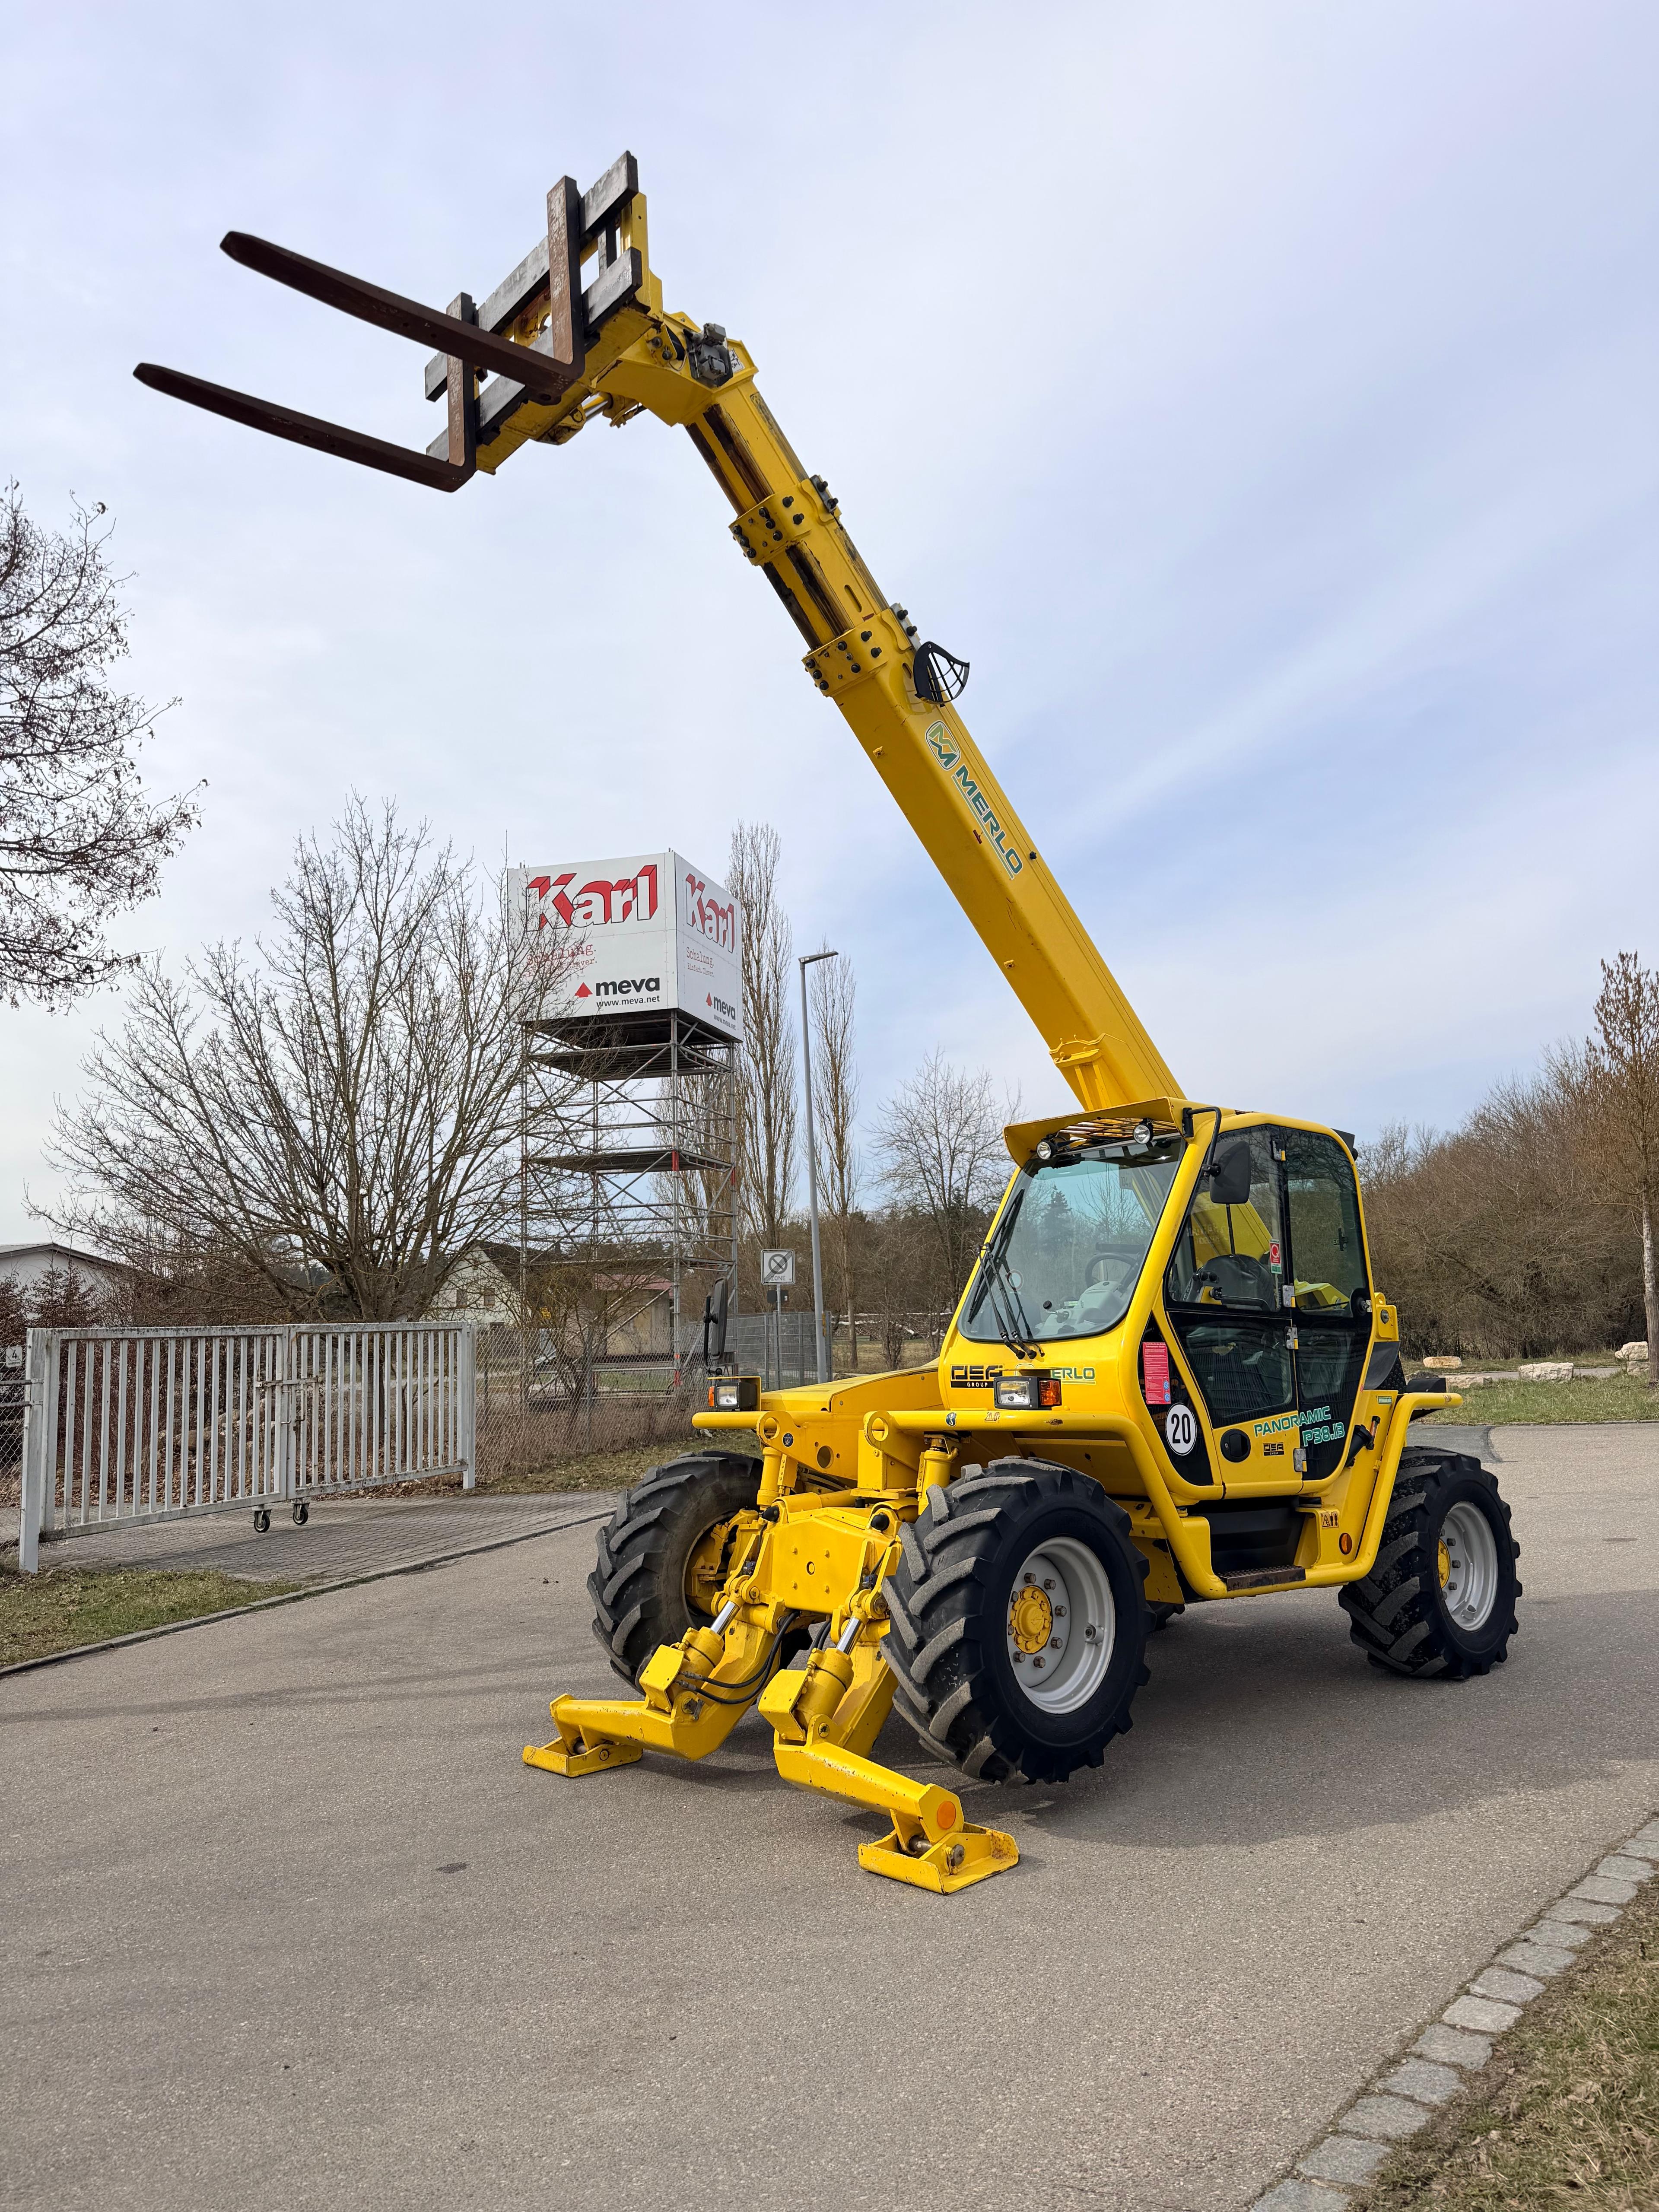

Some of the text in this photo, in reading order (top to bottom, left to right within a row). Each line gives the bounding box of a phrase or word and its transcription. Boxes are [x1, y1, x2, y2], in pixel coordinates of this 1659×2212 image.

[955, 764, 1023, 874] MERLO
[526, 864, 658, 931] Karl
[686, 873, 734, 953] Karl
[596, 977, 660, 996] meva
[596, 995, 660, 1007] www.meva.net
[713, 996, 736, 1020] meva
[12, 1350, 17, 1359] 4
[1052, 1368, 1095, 1379] ERLO
[1171, 1413, 1191, 1444] 20
[1253, 1405, 1331, 1438] PANORAMIC
[1302, 1422, 1345, 1447] P38.13
